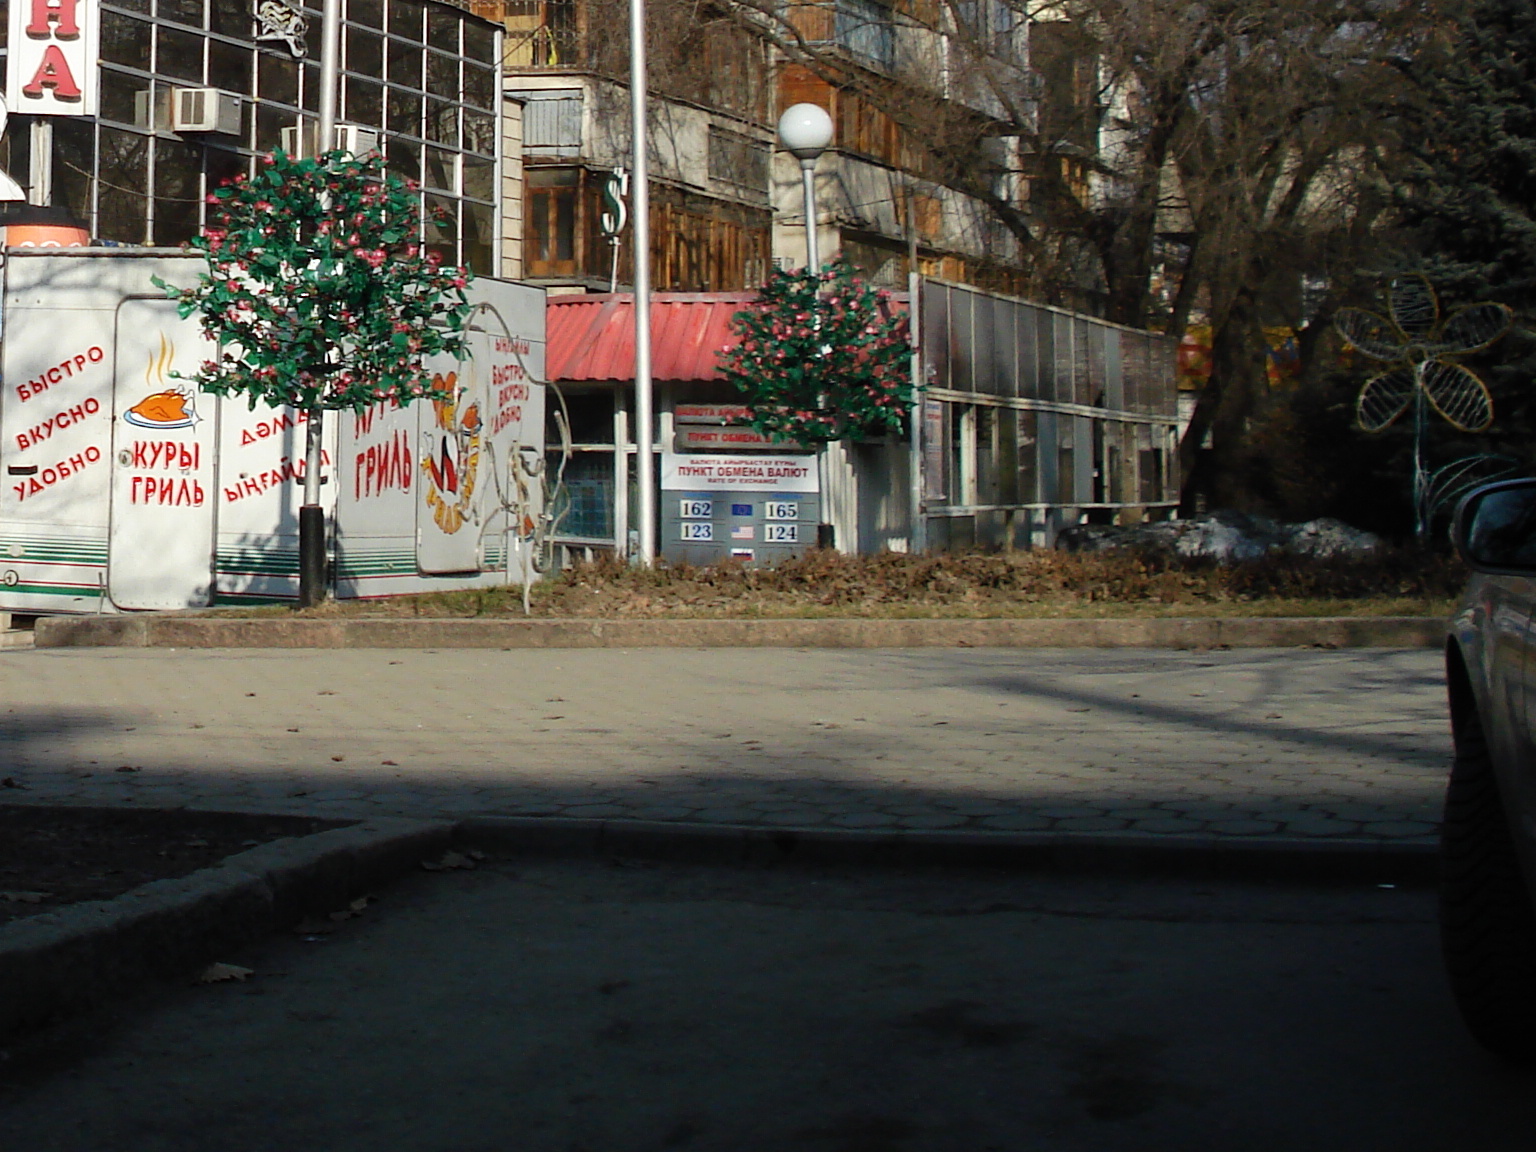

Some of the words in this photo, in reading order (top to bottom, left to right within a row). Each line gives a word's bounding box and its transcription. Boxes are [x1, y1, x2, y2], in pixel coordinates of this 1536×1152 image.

[15, 345, 105, 403] БЫСТРО
[492, 364, 524, 385] БЫСТРО
[15, 396, 101, 451] ВКУСНО
[132, 439, 201, 472] КУРЫ
[355, 429, 412, 502] ГРИЛЬ
[13, 445, 102, 502] УДОБНО
[678, 466, 714, 476] ПУНКТ
[717, 467, 764, 477] ОБМЕНА
[767, 468, 809, 478] ВАЛЮТ
[131, 476, 205, 509] ГРИЛЬ
[683, 502, 712, 516] 162
[769, 504, 798, 518] 165
[684, 524, 712, 539] 123
[768, 526, 798, 540] 124
